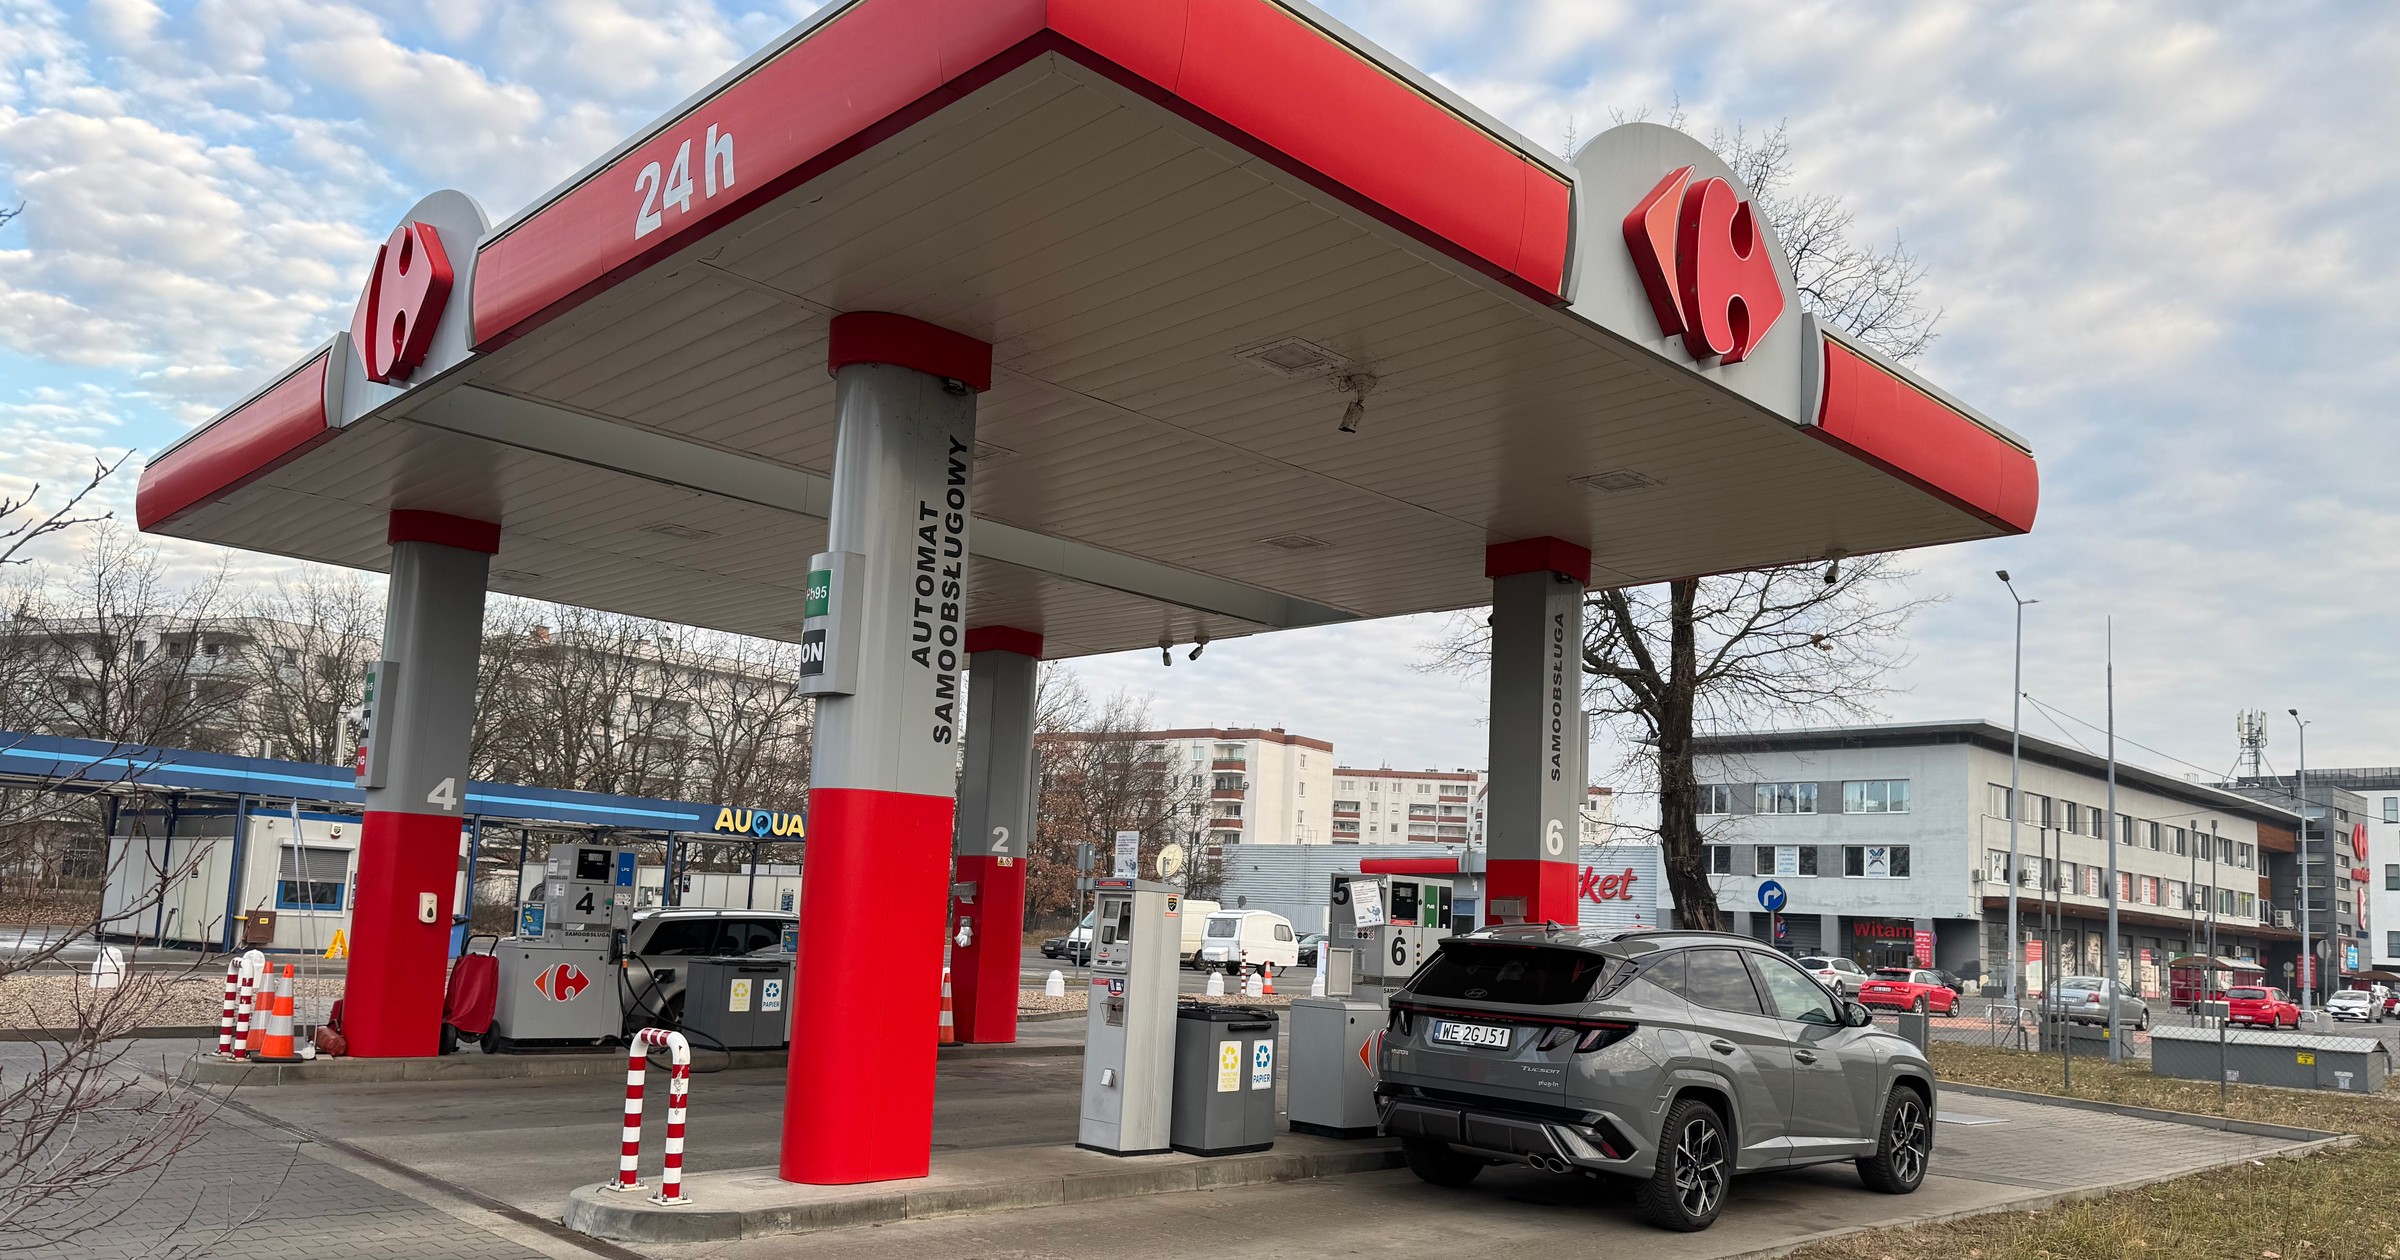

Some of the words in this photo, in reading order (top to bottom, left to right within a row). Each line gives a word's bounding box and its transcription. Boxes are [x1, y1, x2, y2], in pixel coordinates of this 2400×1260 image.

[634, 138, 694, 241] 24
[705, 122, 735, 200] h
[912, 500, 938, 669] AUTOMAT
[932, 434, 968, 745] SAMOOBSŁUGOWY
[801, 641, 824, 664] ON
[1550, 612, 1564, 782] SAMOOBSŁUGA
[427, 777, 457, 811] 4
[714, 807, 805, 838] AUQUA
[1545, 818, 1564, 856] 6
[991, 826, 1009, 853] 2
[1333, 877, 1350, 906] 5
[1579, 866, 1638, 904] ket
[575, 892, 595, 915] 4
[1391, 936, 1407, 966] 6
[762, 1001, 780, 1009] PAPIER
[1442, 1023, 1460, 1040] WE
[1463, 1026, 1505, 1045] 2GJ51
[1252, 1074, 1271, 1084] PAPIER
